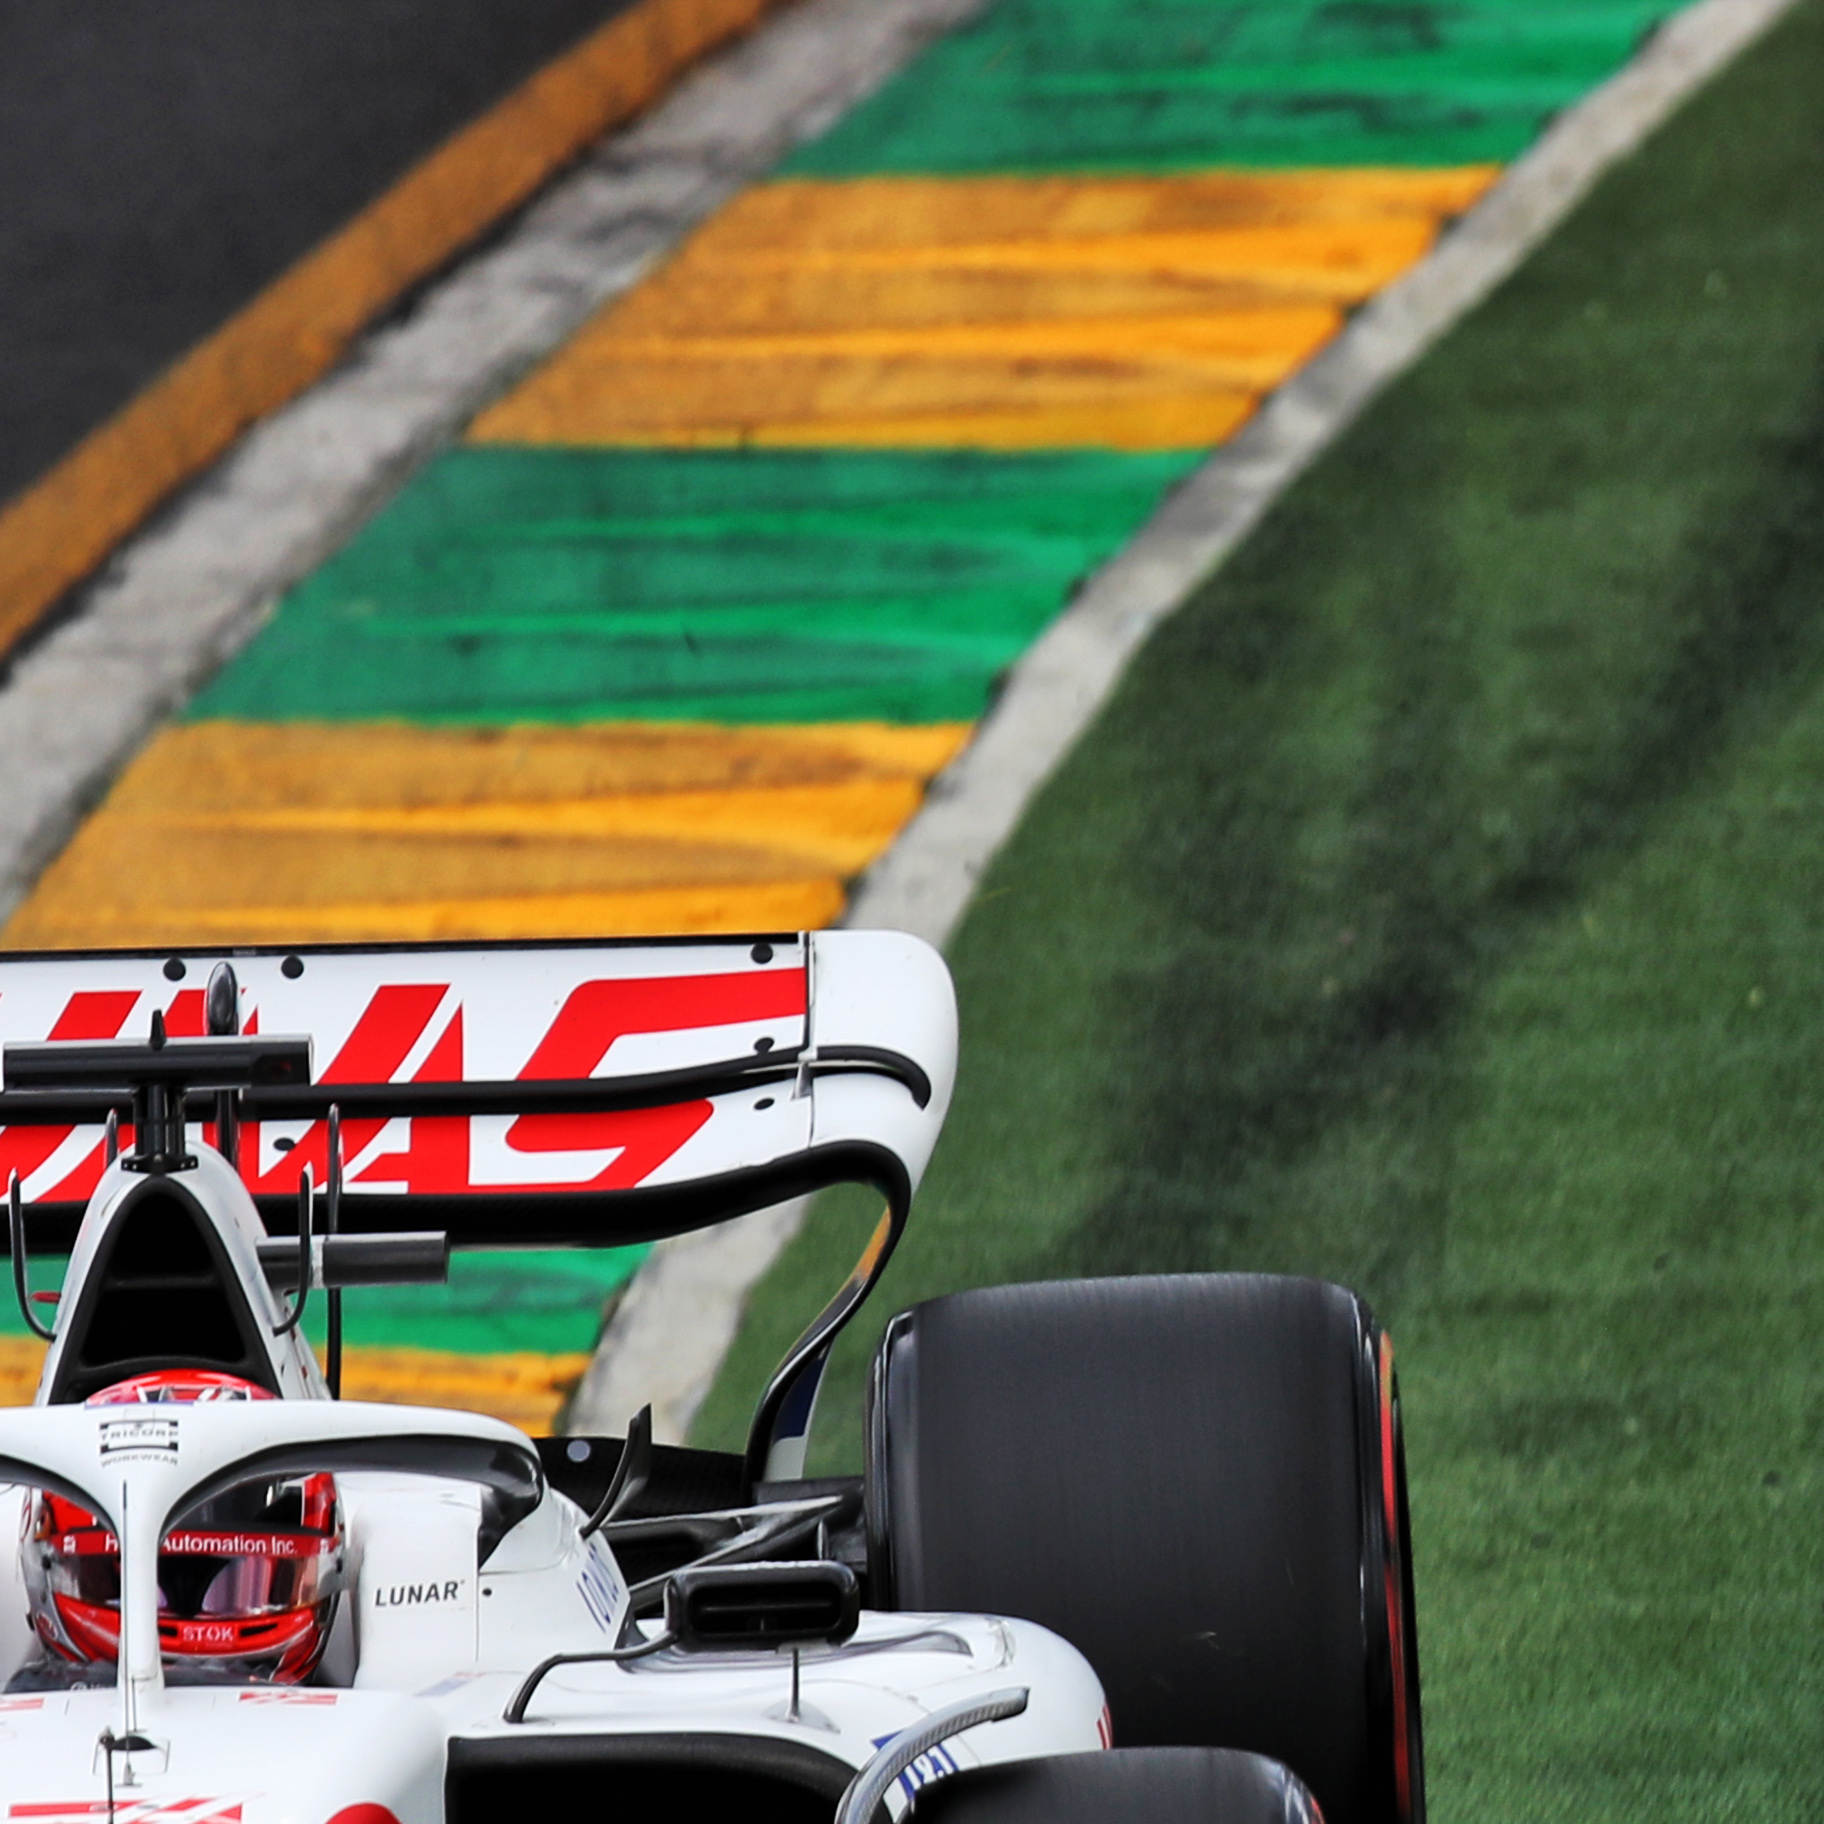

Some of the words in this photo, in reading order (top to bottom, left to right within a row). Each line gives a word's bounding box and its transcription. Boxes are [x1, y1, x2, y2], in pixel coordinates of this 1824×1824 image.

[100, 1453, 179, 1468] WORKWEAR
[163, 1535, 266, 1553] Automation
[271, 1535, 298, 1554] Inc.
[374, 1580, 459, 1608] LUNAR
